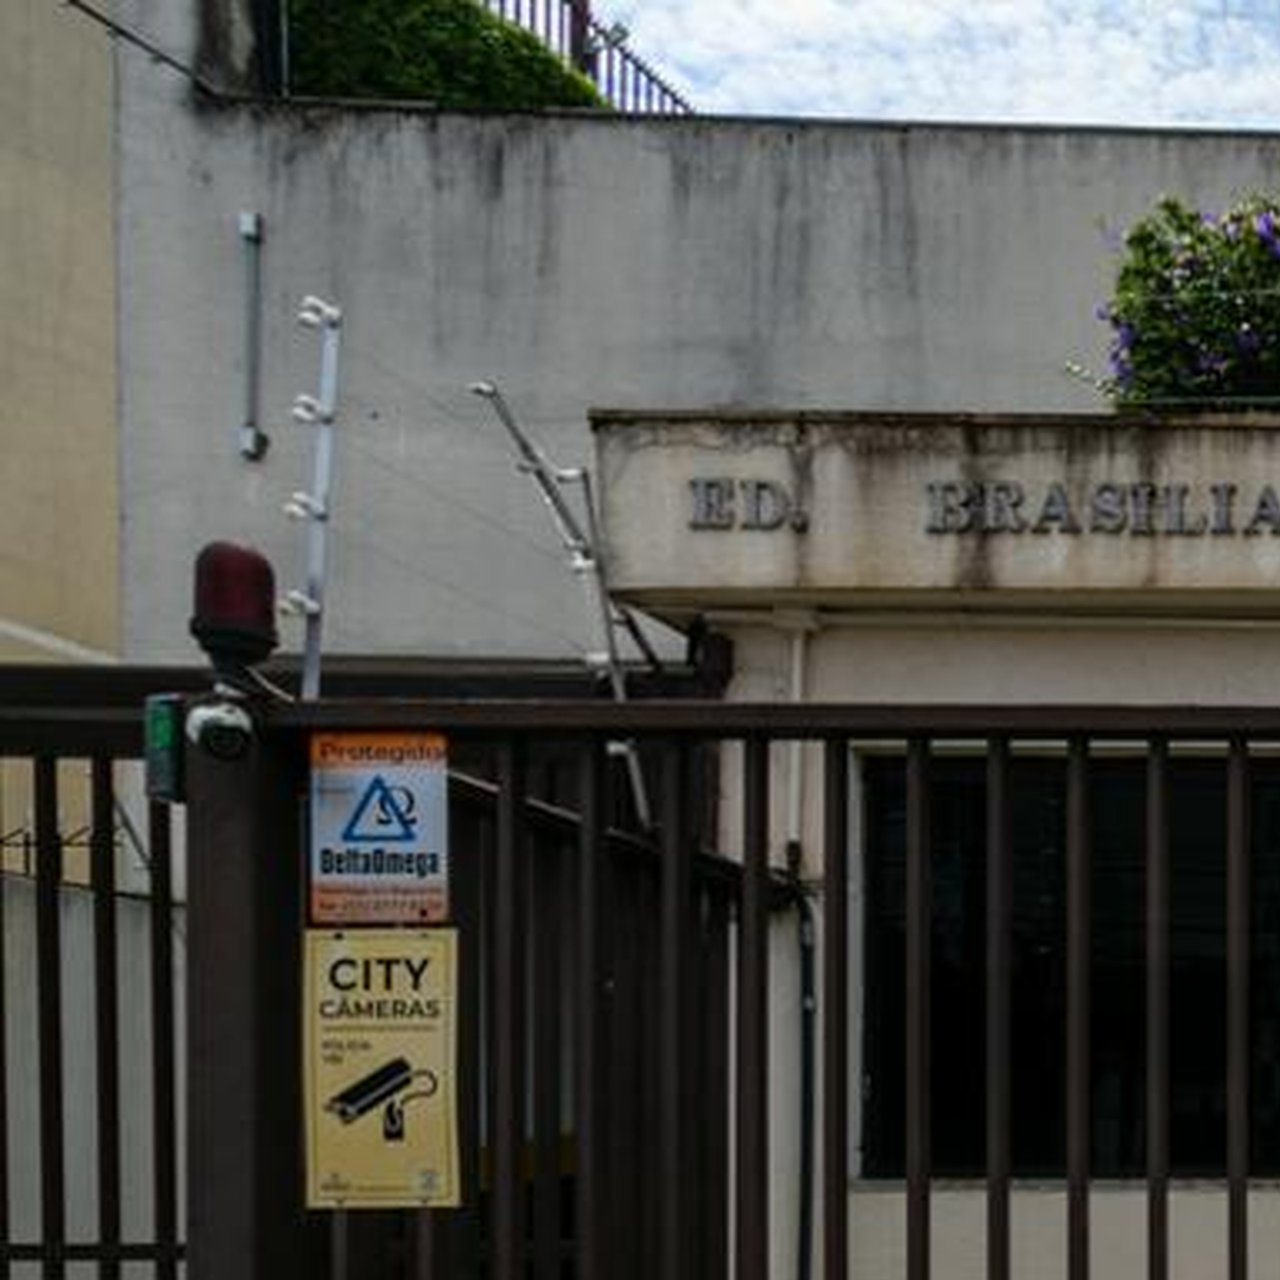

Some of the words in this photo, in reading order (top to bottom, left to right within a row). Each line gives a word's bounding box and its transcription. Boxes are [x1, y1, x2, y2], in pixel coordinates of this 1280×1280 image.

[688, 479, 809, 534] ED.
[319, 849, 440, 878] DeltaOmega
[328, 958, 430, 991] CITY
